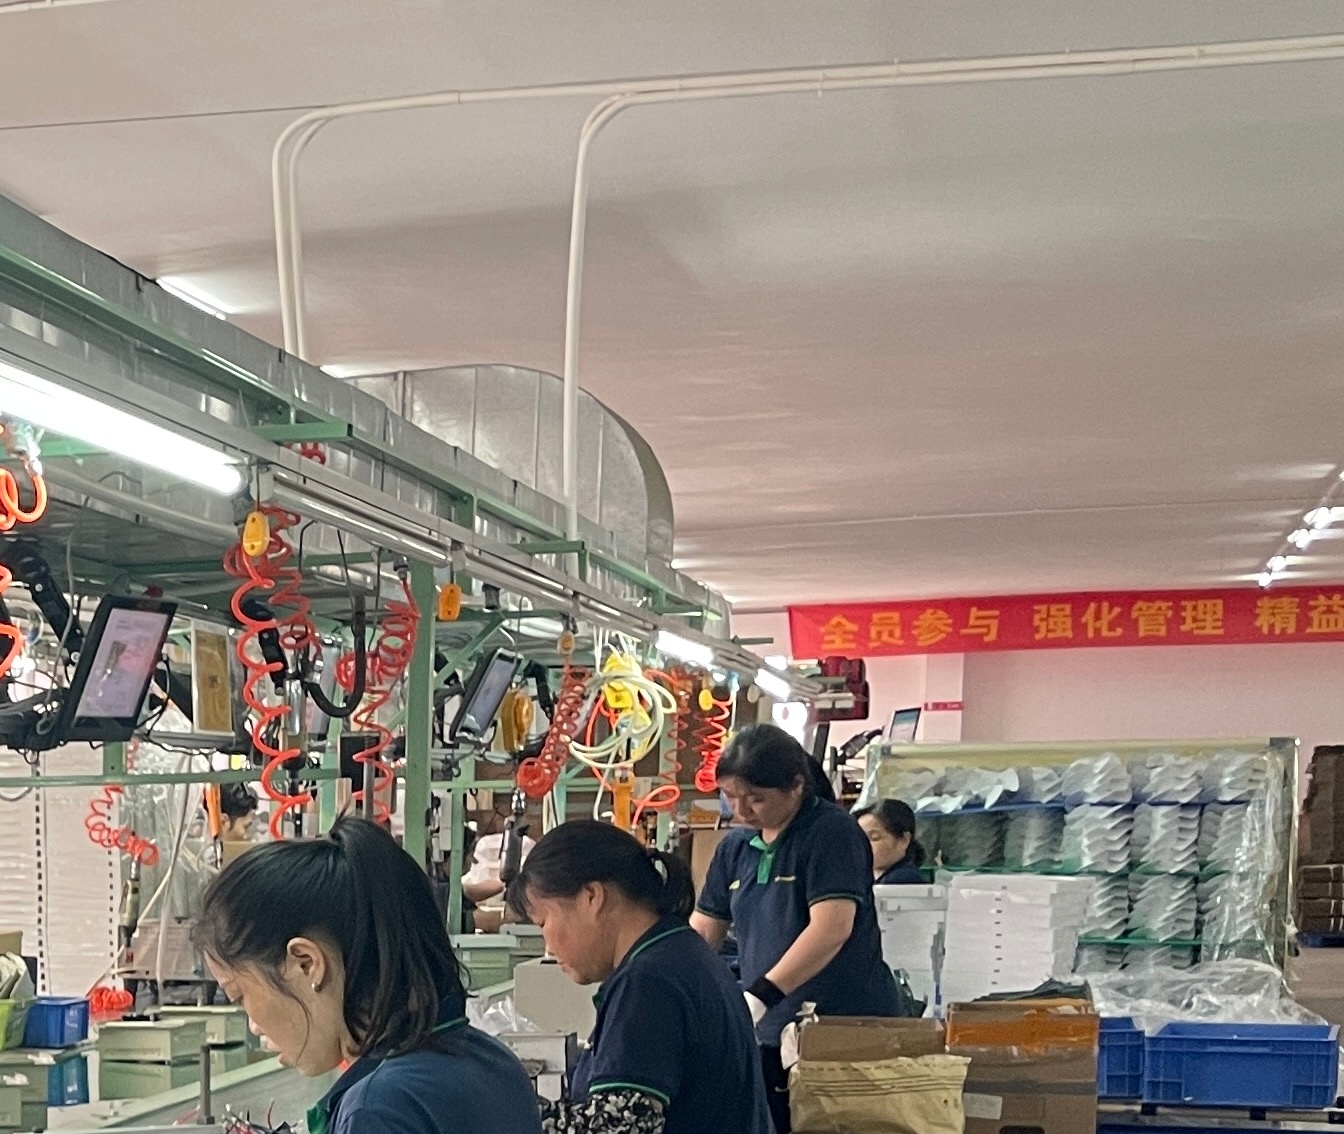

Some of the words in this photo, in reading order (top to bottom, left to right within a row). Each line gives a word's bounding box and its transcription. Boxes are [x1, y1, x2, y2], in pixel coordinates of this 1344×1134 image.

[819, 606, 1000, 650] 全员参与
[1033, 597, 1224, 640] 强化管理
[1254, 593, 1344, 635] 精益
